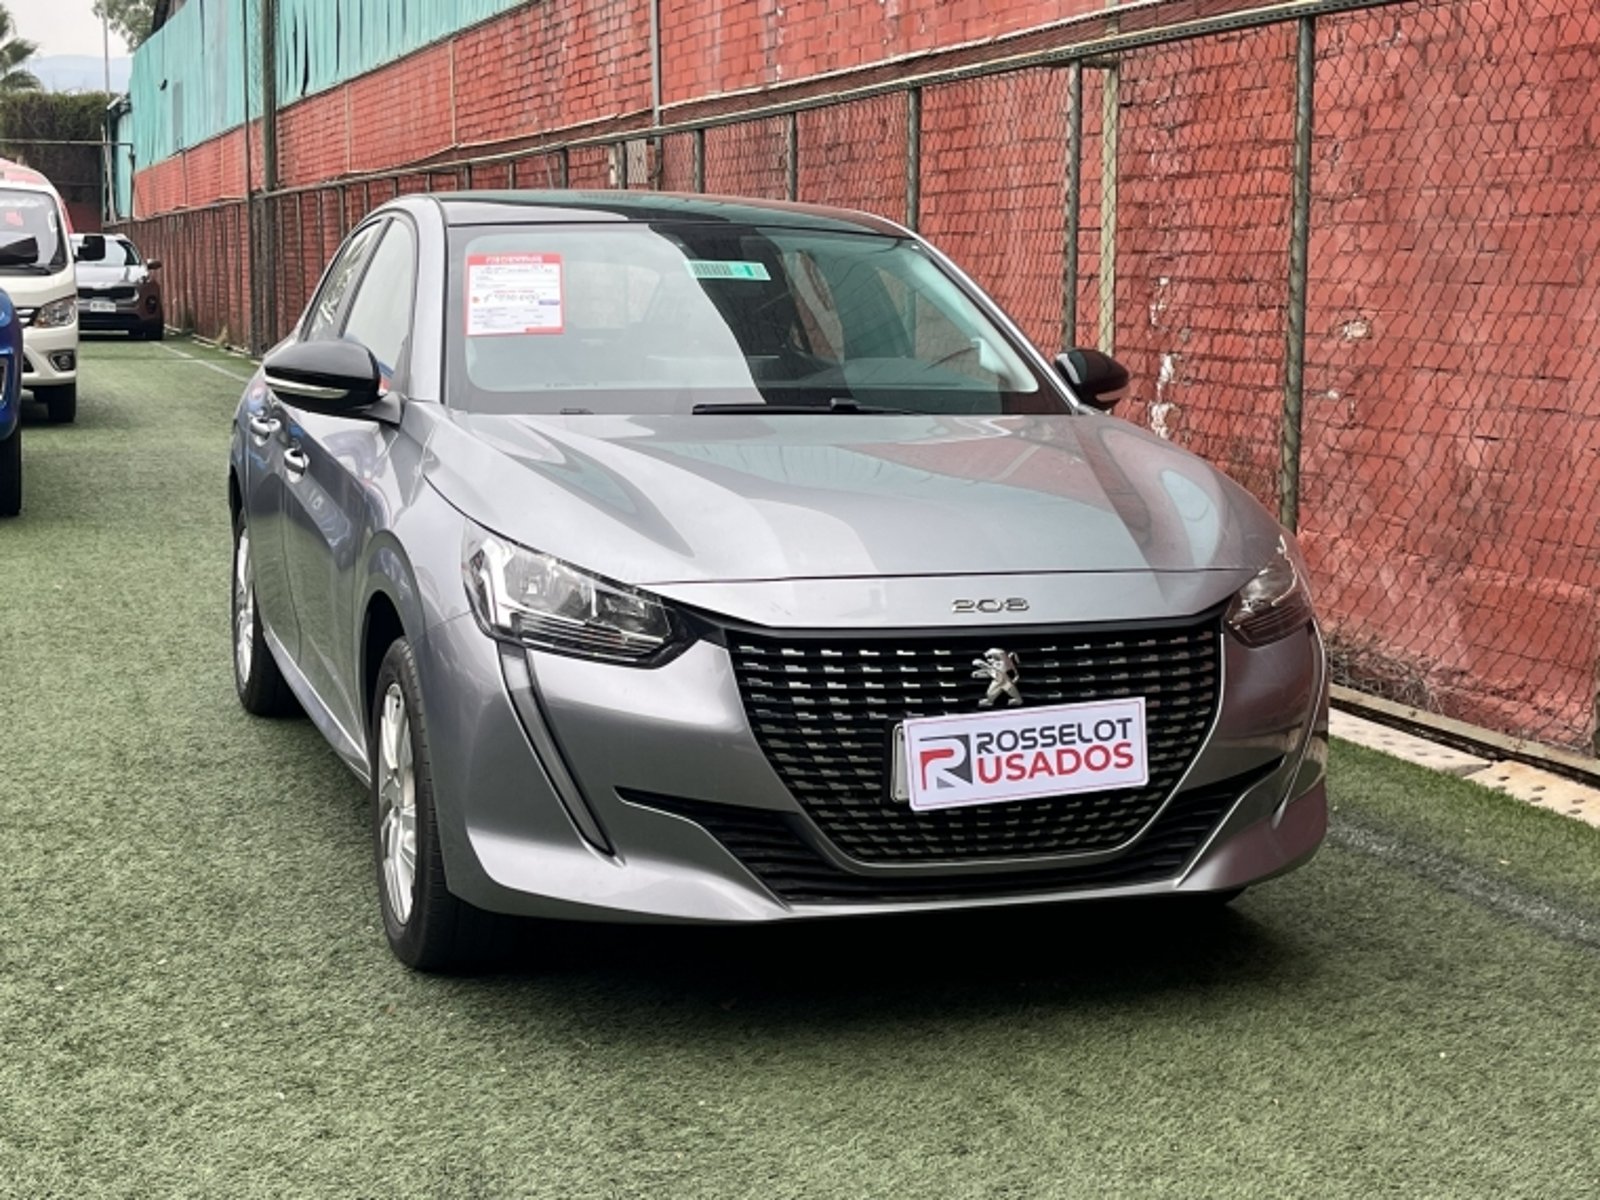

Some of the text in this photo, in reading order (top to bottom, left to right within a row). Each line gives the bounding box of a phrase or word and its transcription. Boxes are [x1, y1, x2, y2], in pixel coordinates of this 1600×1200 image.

[952, 598, 1030, 613] 208
[976, 718, 1132, 754] ROSSELOT
[977, 742, 1134, 783] USADOS
